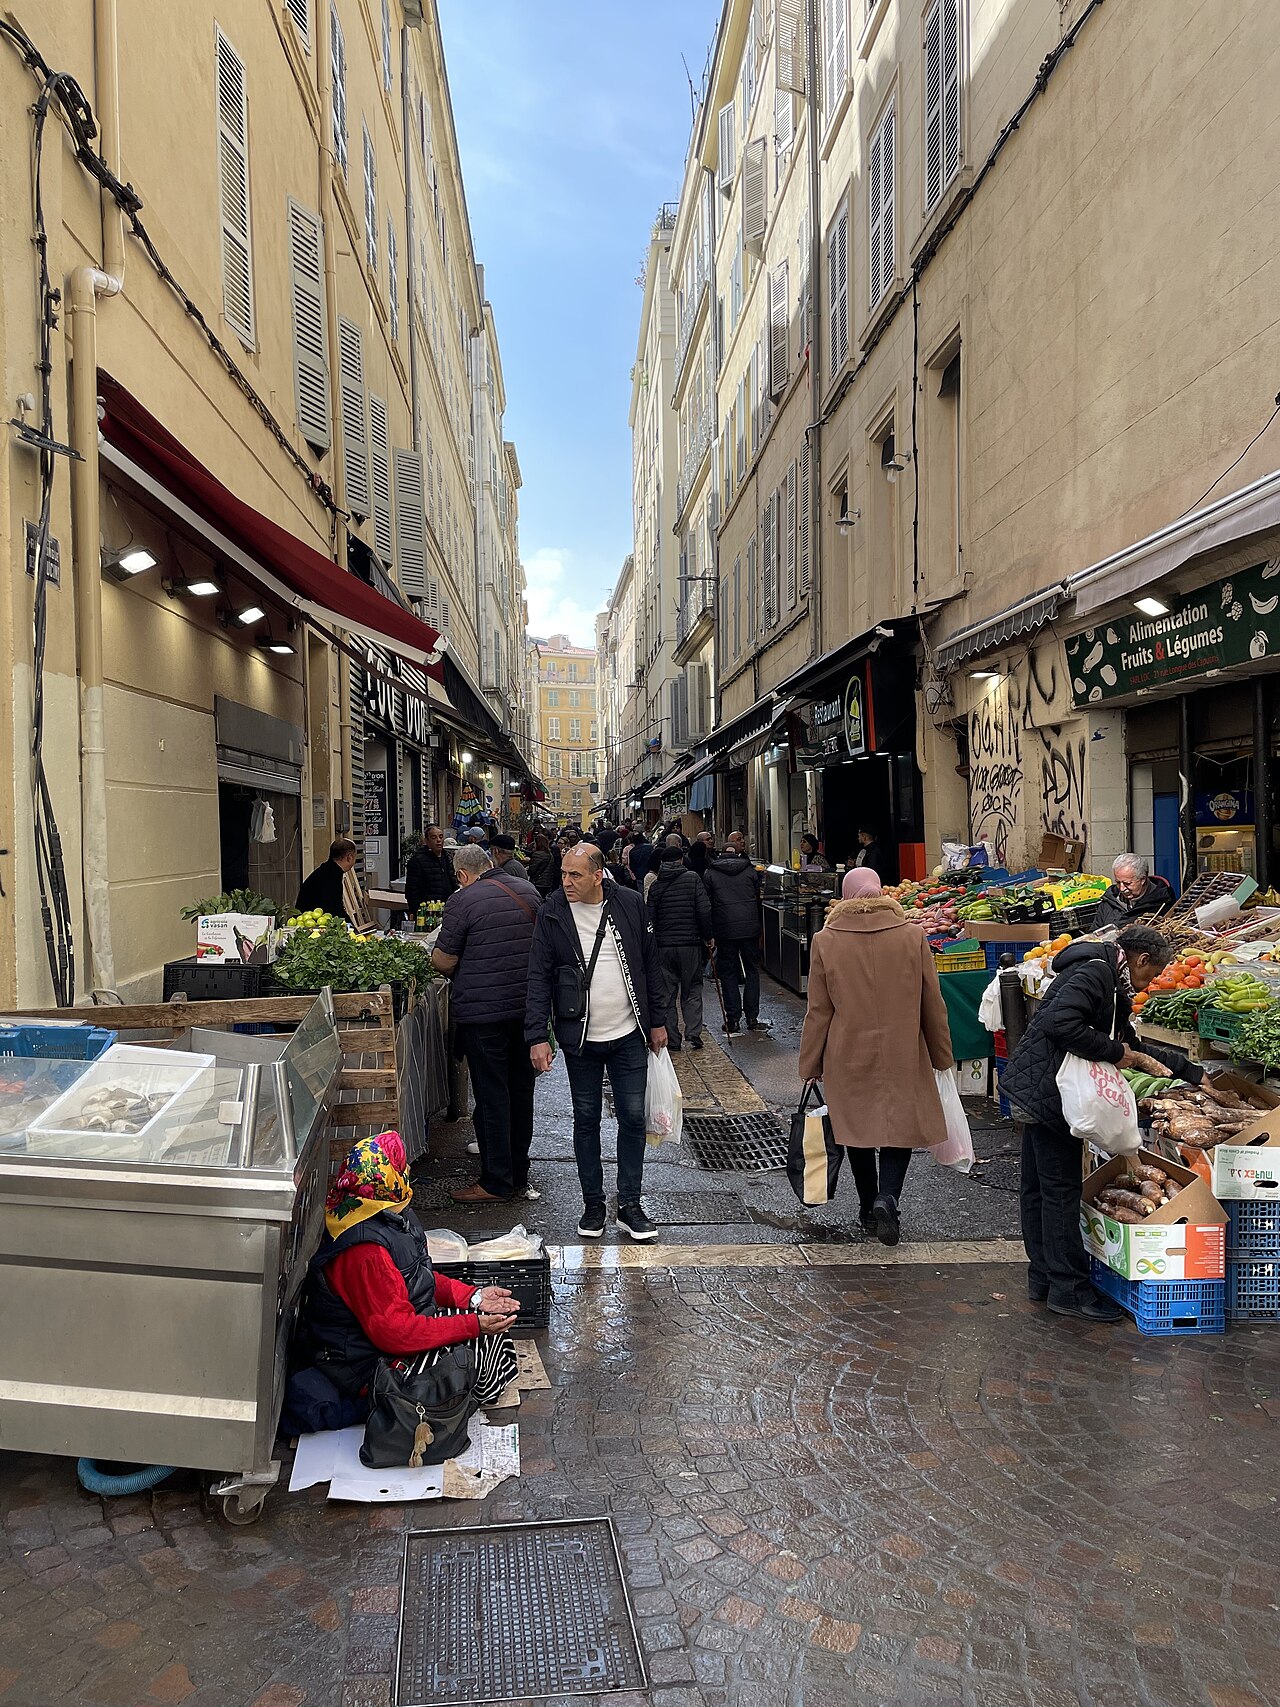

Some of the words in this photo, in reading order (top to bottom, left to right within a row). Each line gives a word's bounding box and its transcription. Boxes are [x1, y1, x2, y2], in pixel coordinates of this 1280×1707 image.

[1129, 603, 1208, 644] Alimentation
[1121, 646, 1154, 671] Fruits
[1155, 641, 1165, 661] &
[1166, 626, 1224, 660] Légumes
[1095, 1078, 1130, 1117] Lady
[1244, 1170, 1272, 1179] MUREX
